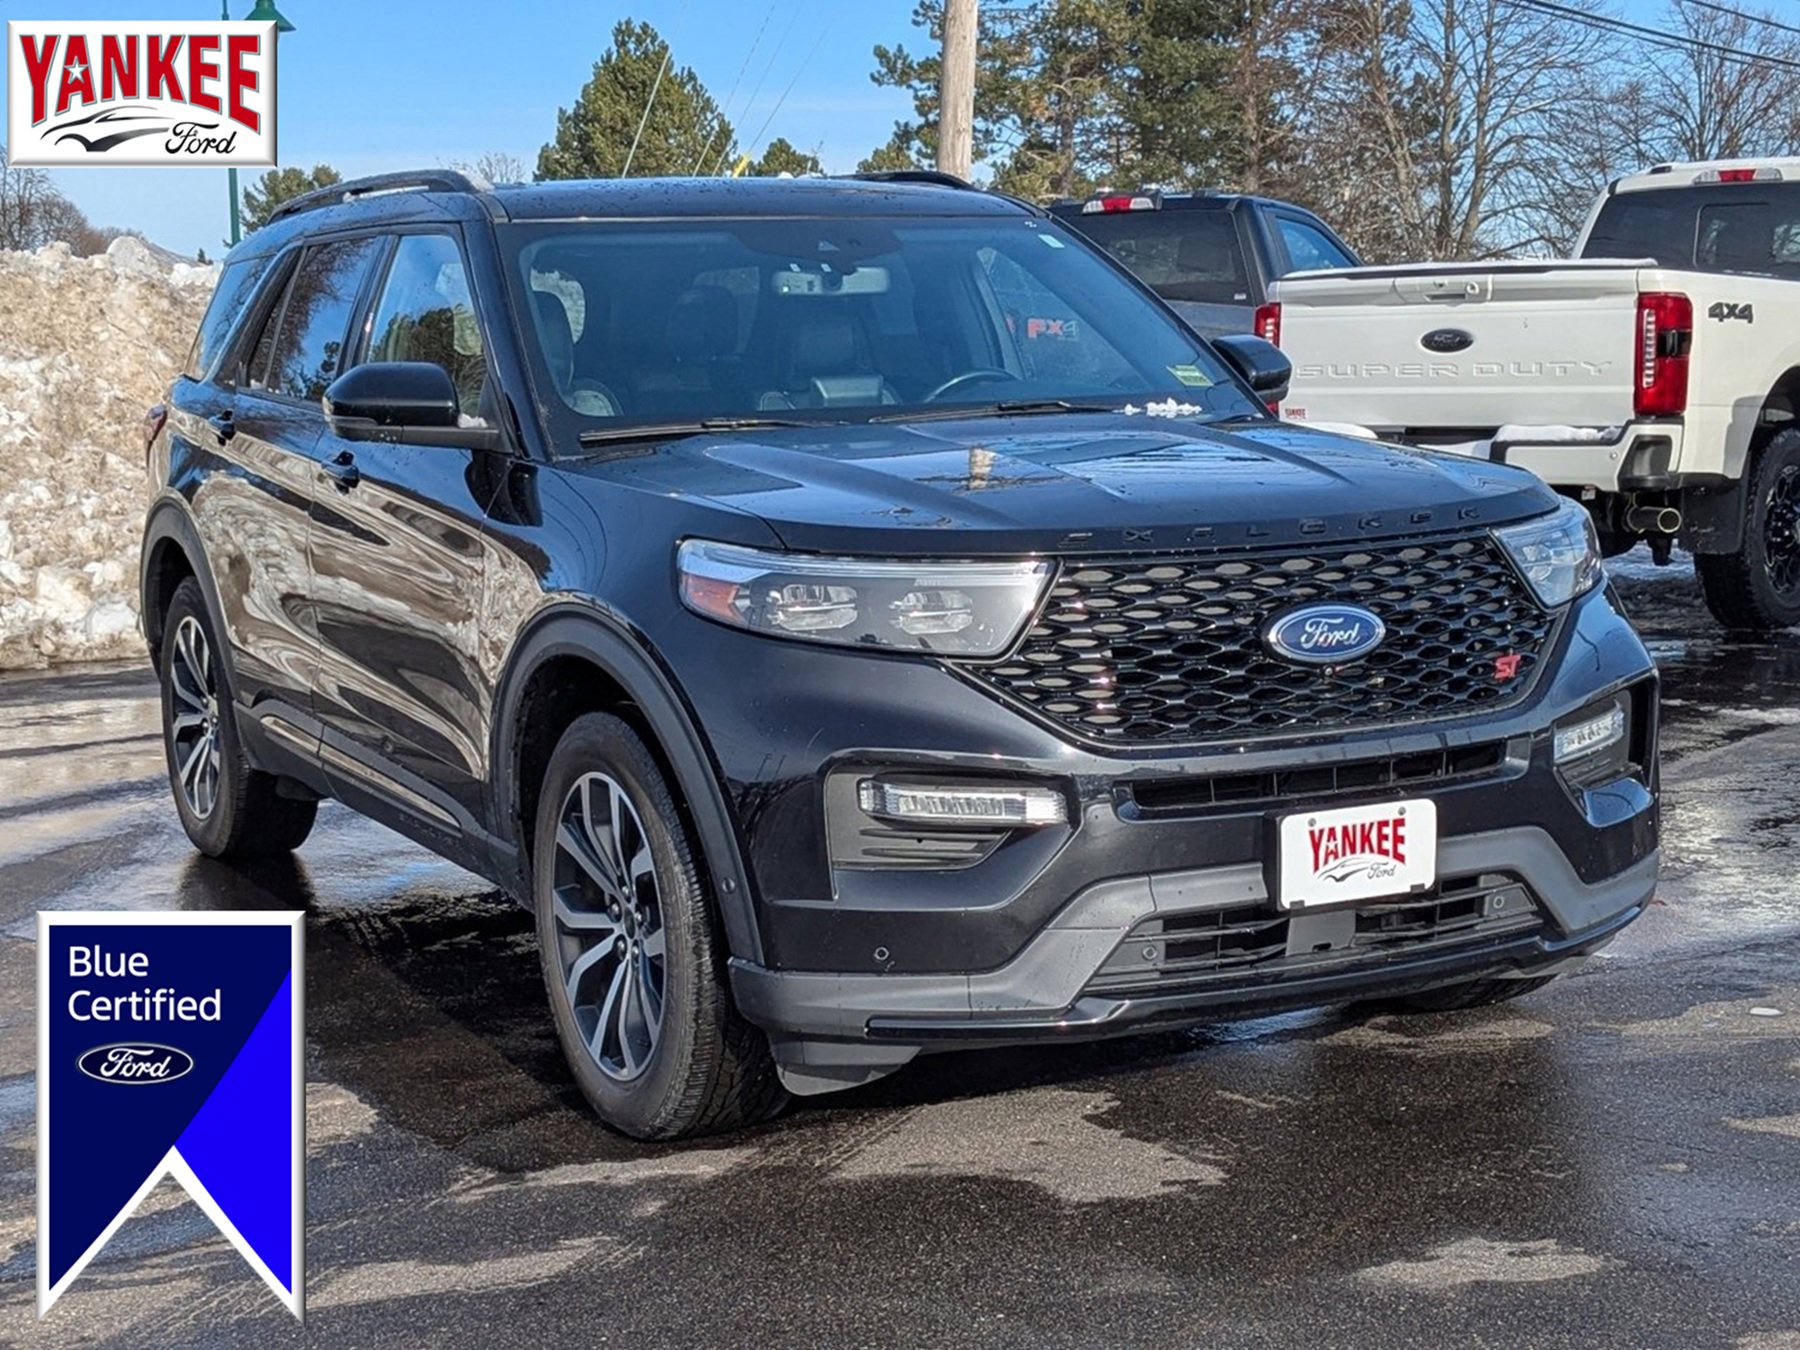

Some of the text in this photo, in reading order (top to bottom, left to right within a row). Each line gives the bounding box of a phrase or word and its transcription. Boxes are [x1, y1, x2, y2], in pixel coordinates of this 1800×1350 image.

[1296, 361, 1612, 379] SUPER DUTY
[1300, 617, 1361, 650] Ford
[1308, 817, 1407, 875] YANKEE
[1367, 861, 1397, 880] Ford
